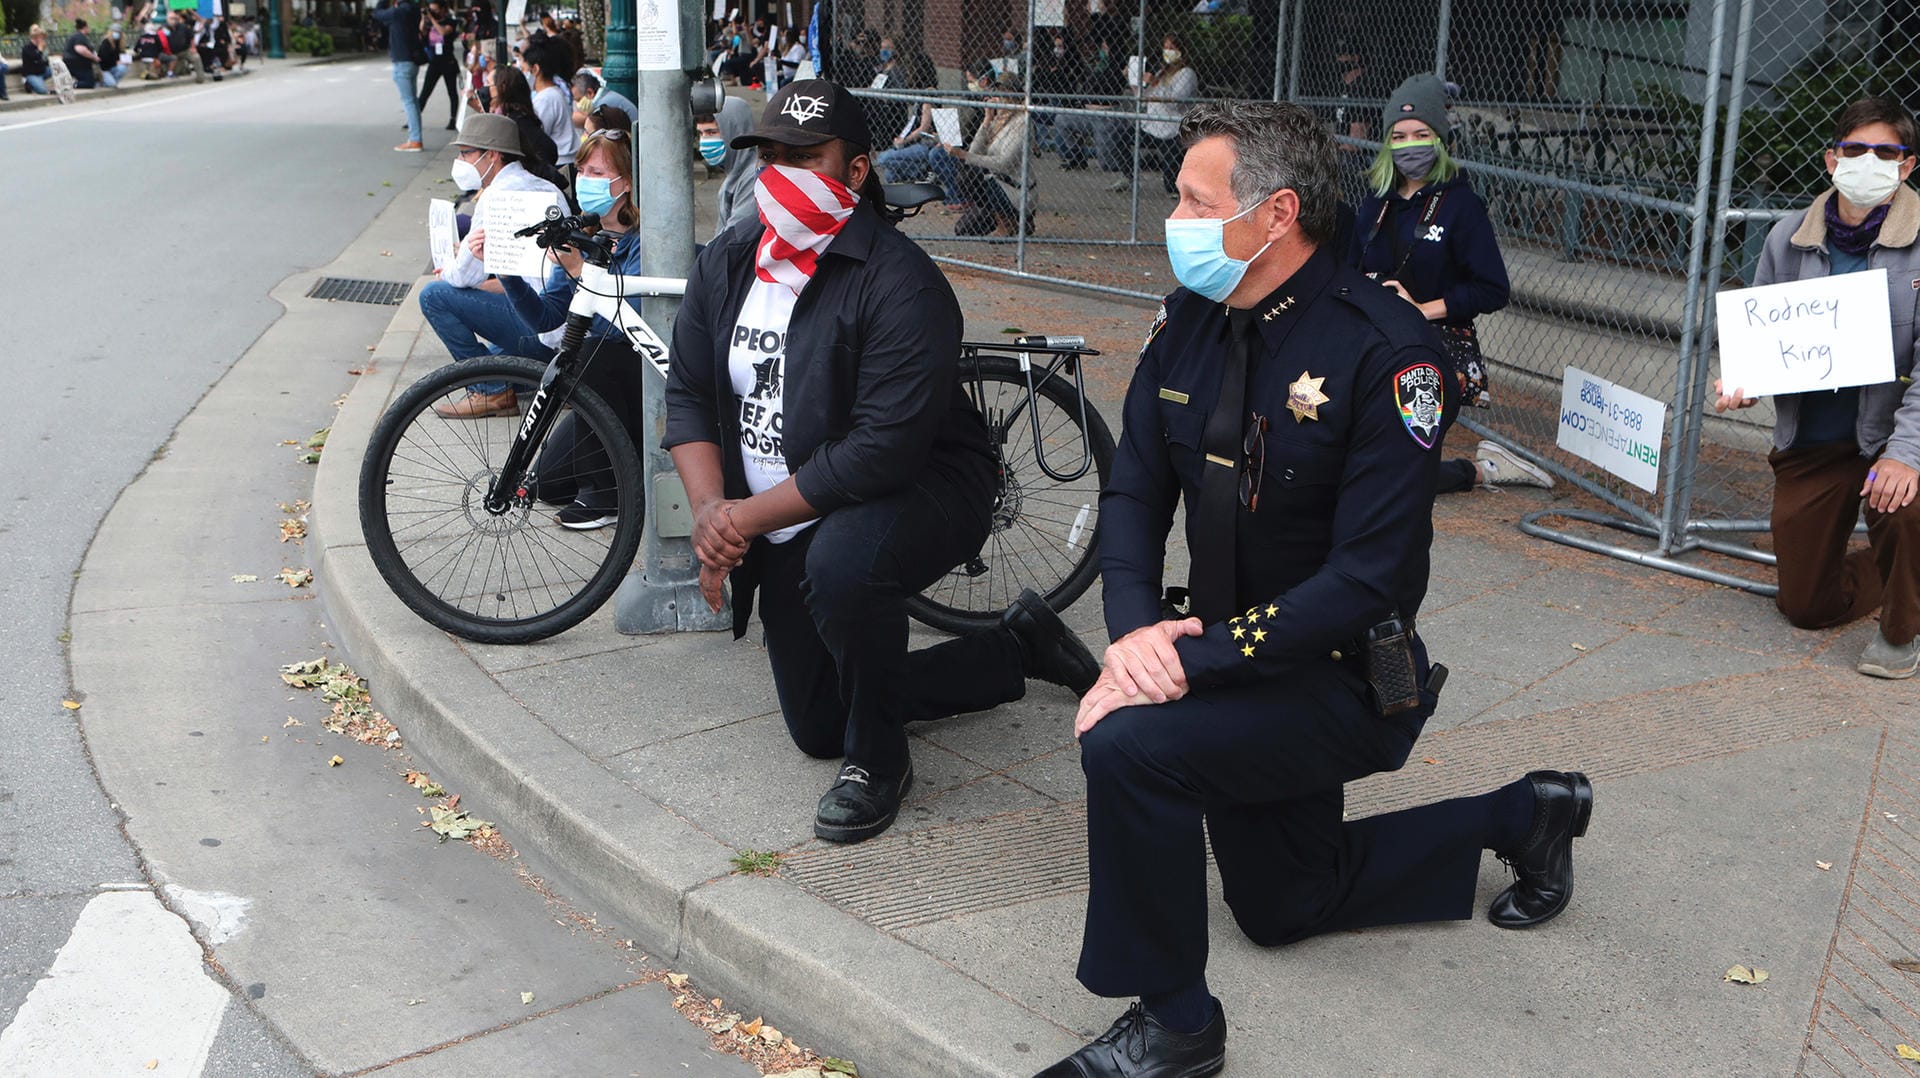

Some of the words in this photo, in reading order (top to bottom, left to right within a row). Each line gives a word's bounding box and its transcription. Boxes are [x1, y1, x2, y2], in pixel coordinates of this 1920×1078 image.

[1744, 297, 1838, 329] Rodney
[1400, 367, 1426, 386] SANTA
[1779, 340, 1832, 380] King
[519, 389, 547, 441] FATTY
[1561, 407, 1658, 468] RENTAFENCE.COM
